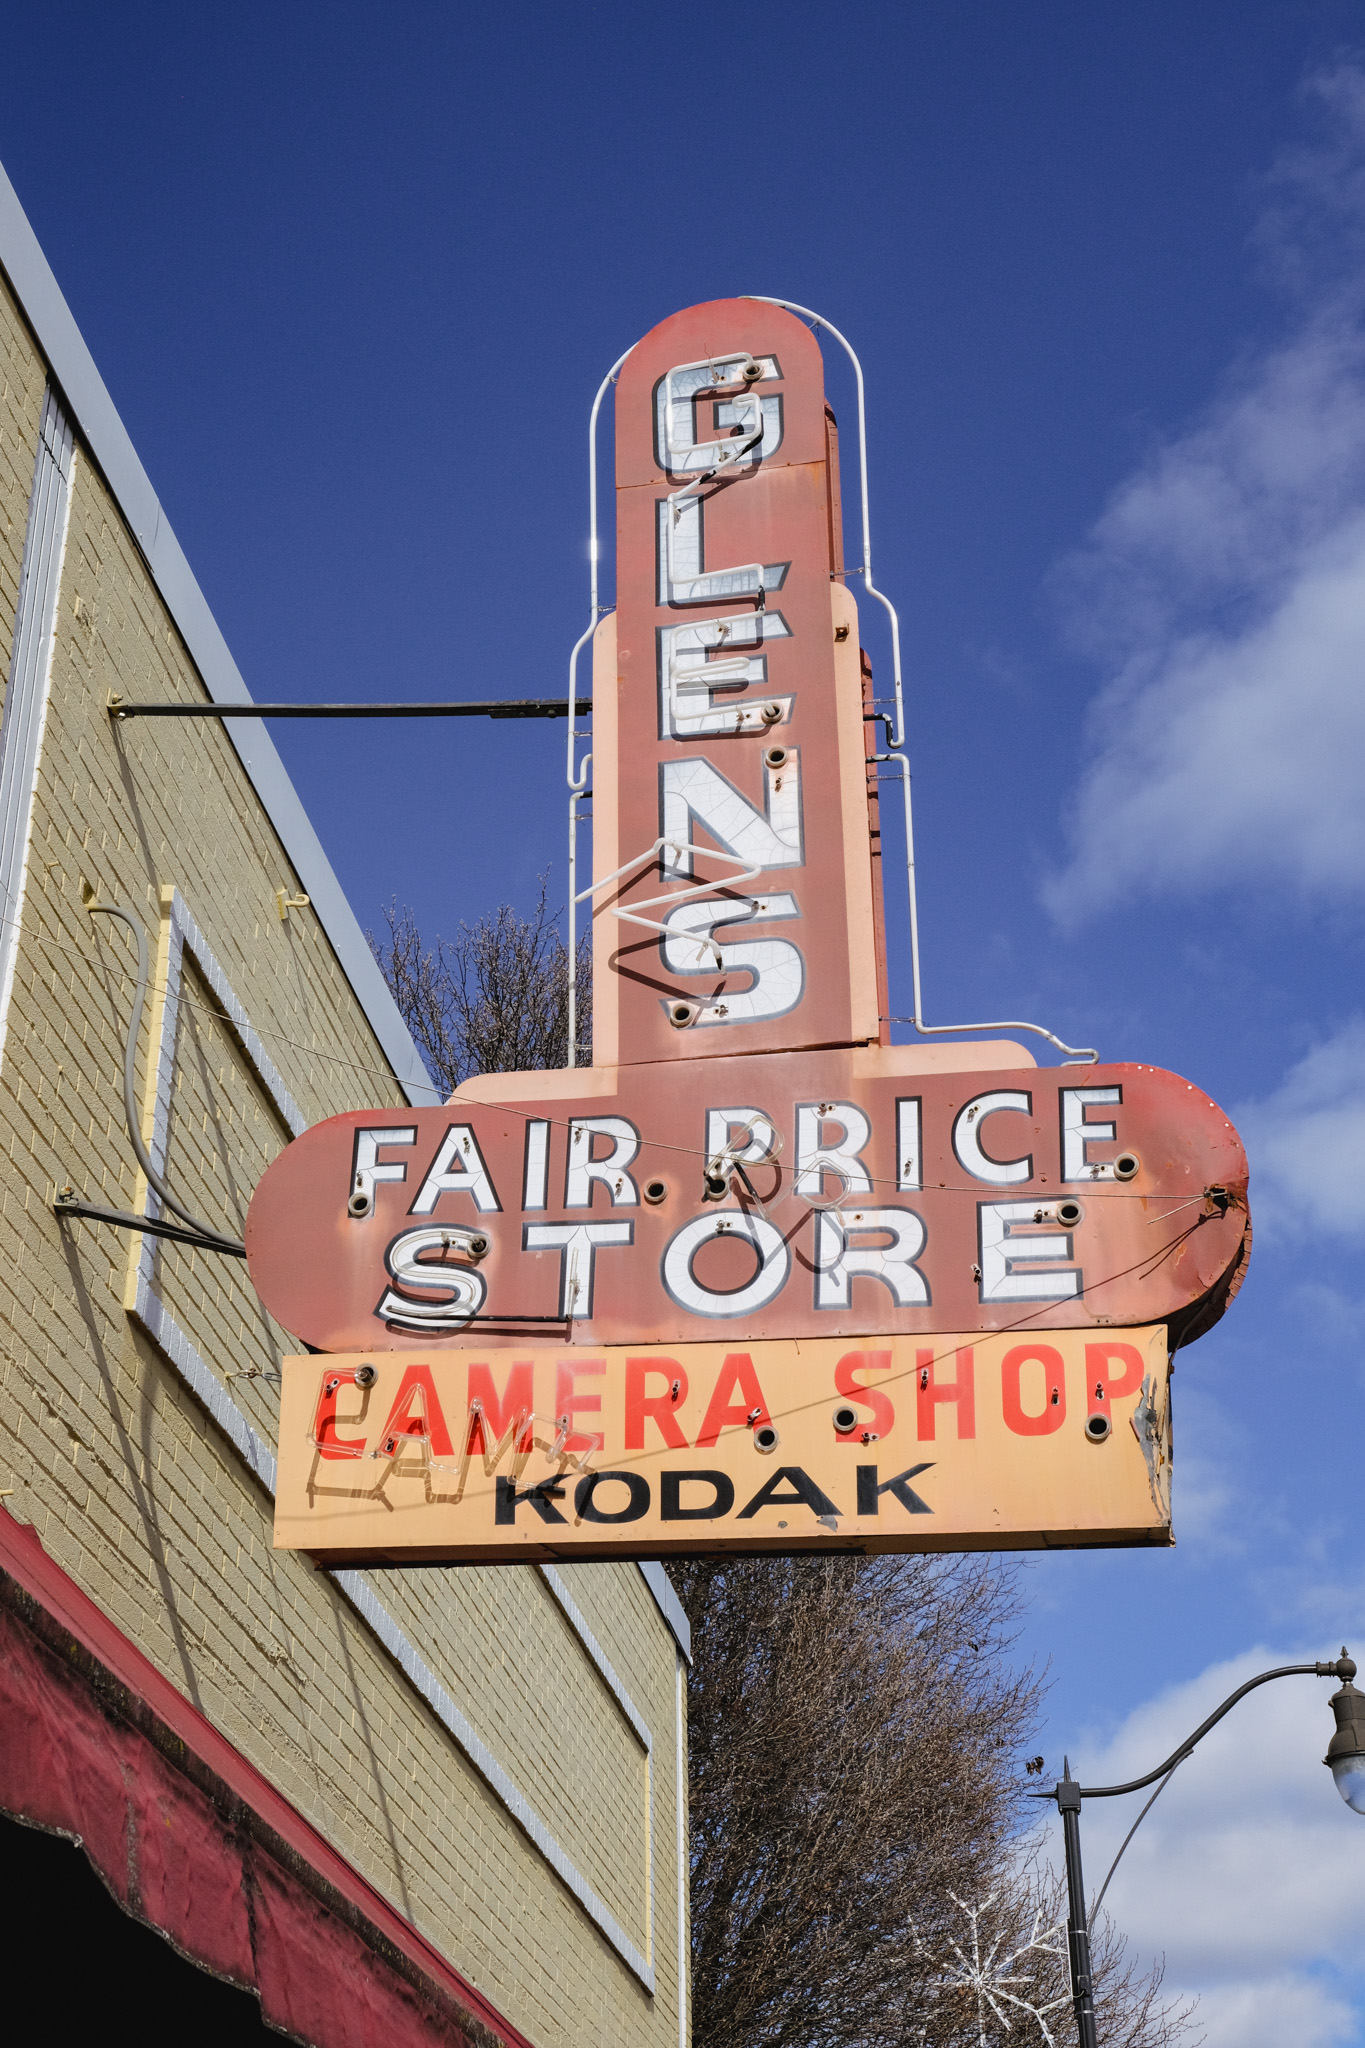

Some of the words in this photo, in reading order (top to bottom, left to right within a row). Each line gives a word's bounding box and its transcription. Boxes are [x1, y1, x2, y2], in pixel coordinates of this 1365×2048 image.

[653, 353, 805, 1031] GLENS
[349, 1113, 642, 1219] FAIR
[704, 1084, 1125, 1197] PRICE
[375, 1199, 1083, 1331] STORE
[316, 1353, 771, 1460] CAMERA
[834, 1341, 1145, 1444] SHOP
[494, 1462, 935, 1525] KODAK
